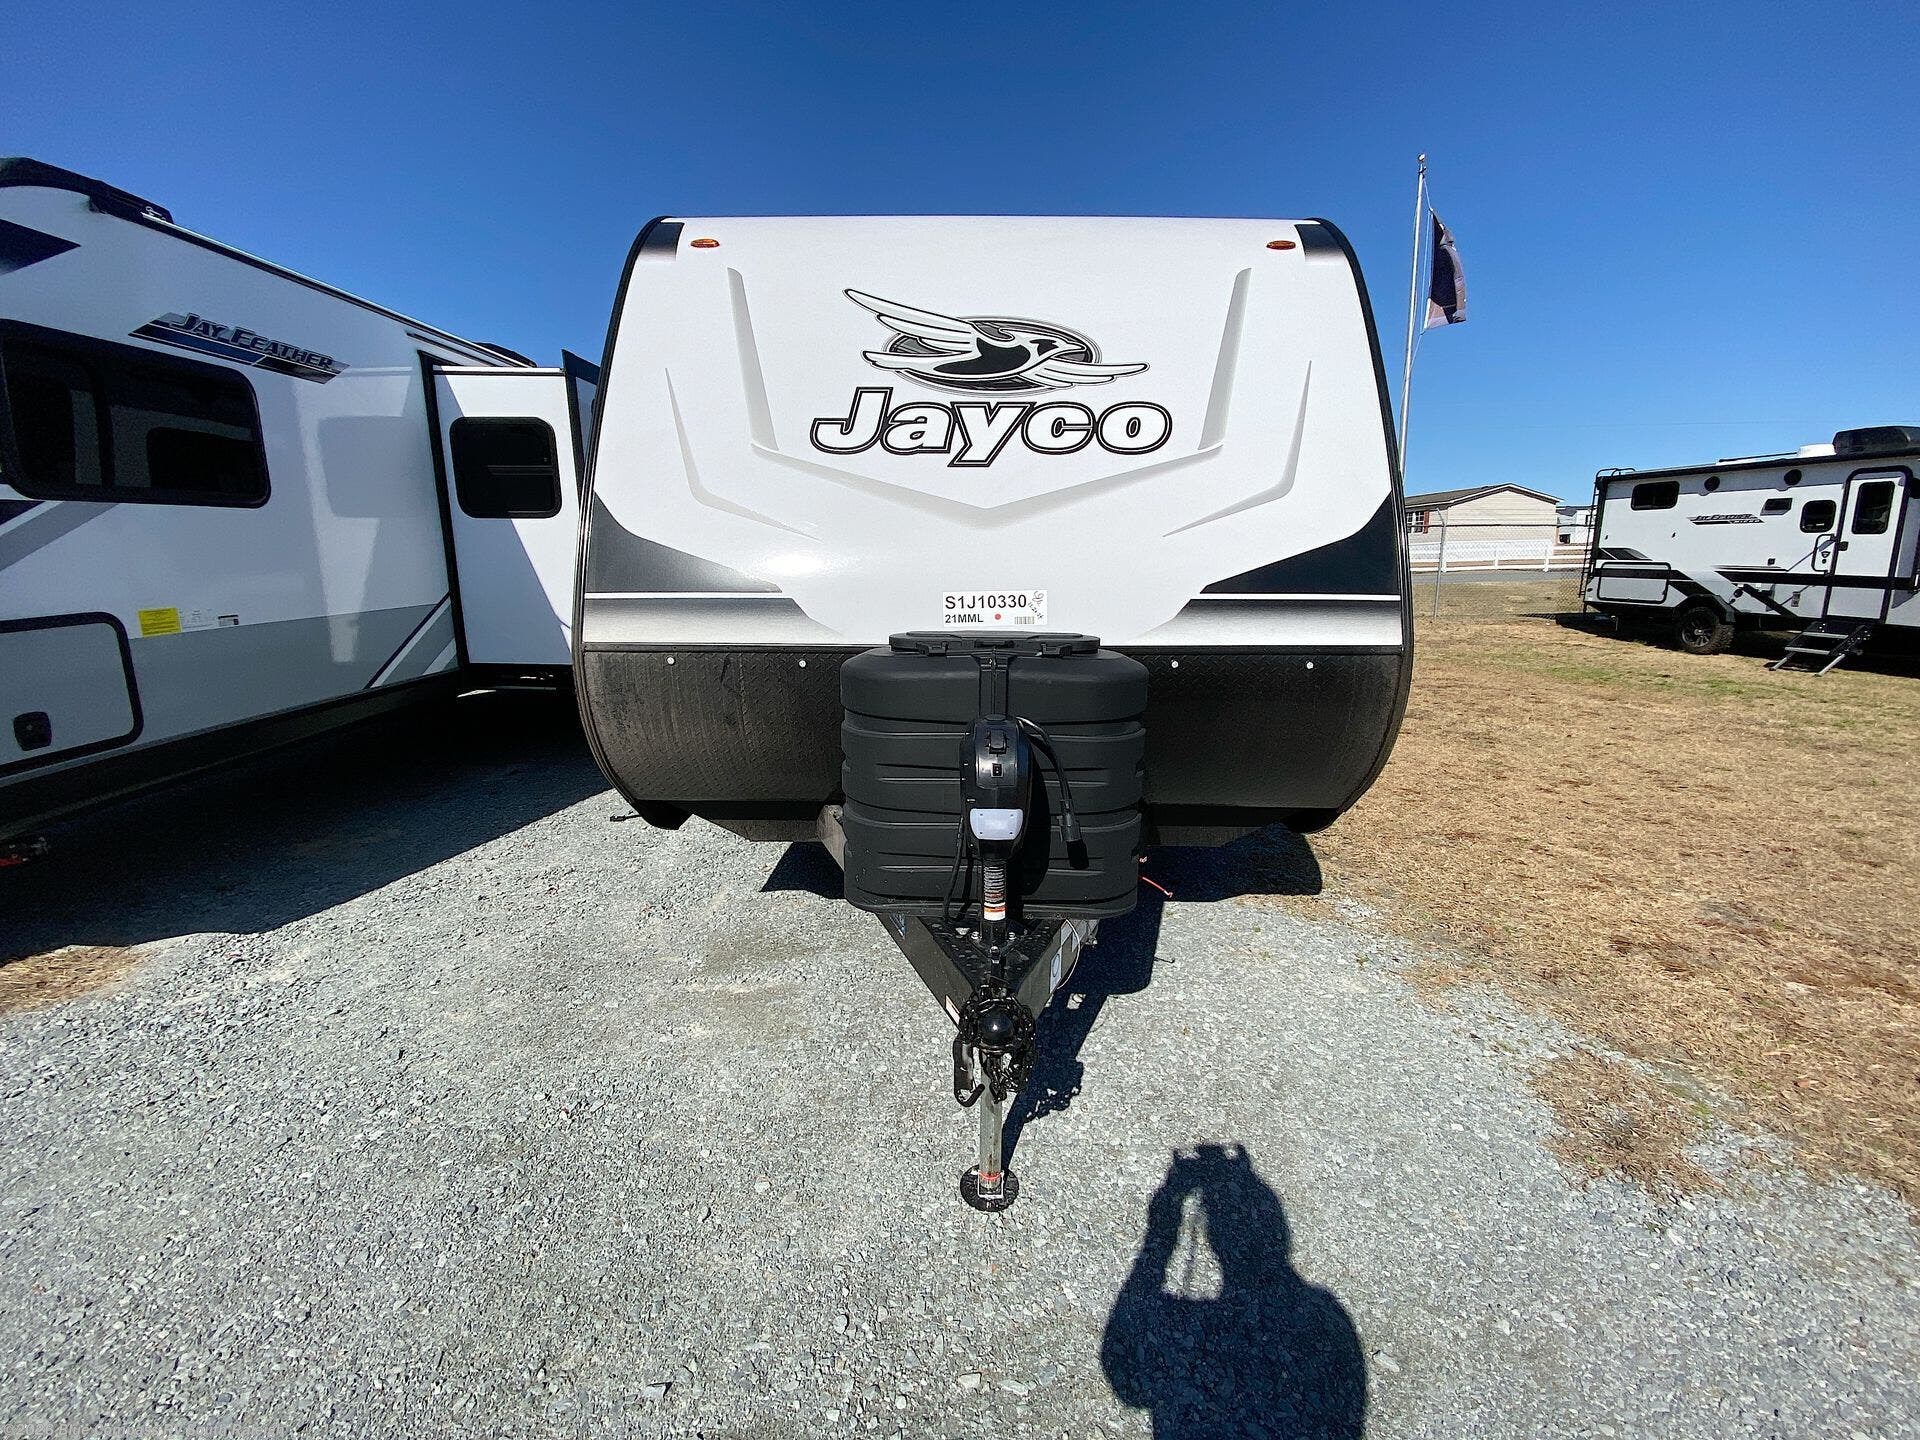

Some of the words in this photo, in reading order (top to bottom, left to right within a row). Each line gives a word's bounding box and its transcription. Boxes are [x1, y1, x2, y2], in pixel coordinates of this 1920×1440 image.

[169, 312, 227, 340] JAY
[229, 327, 334, 369] FEATHER
[810, 386, 1173, 468] Jayco
[944, 614, 984, 623] 21MML
[945, 595, 1027, 609] S1J10330
